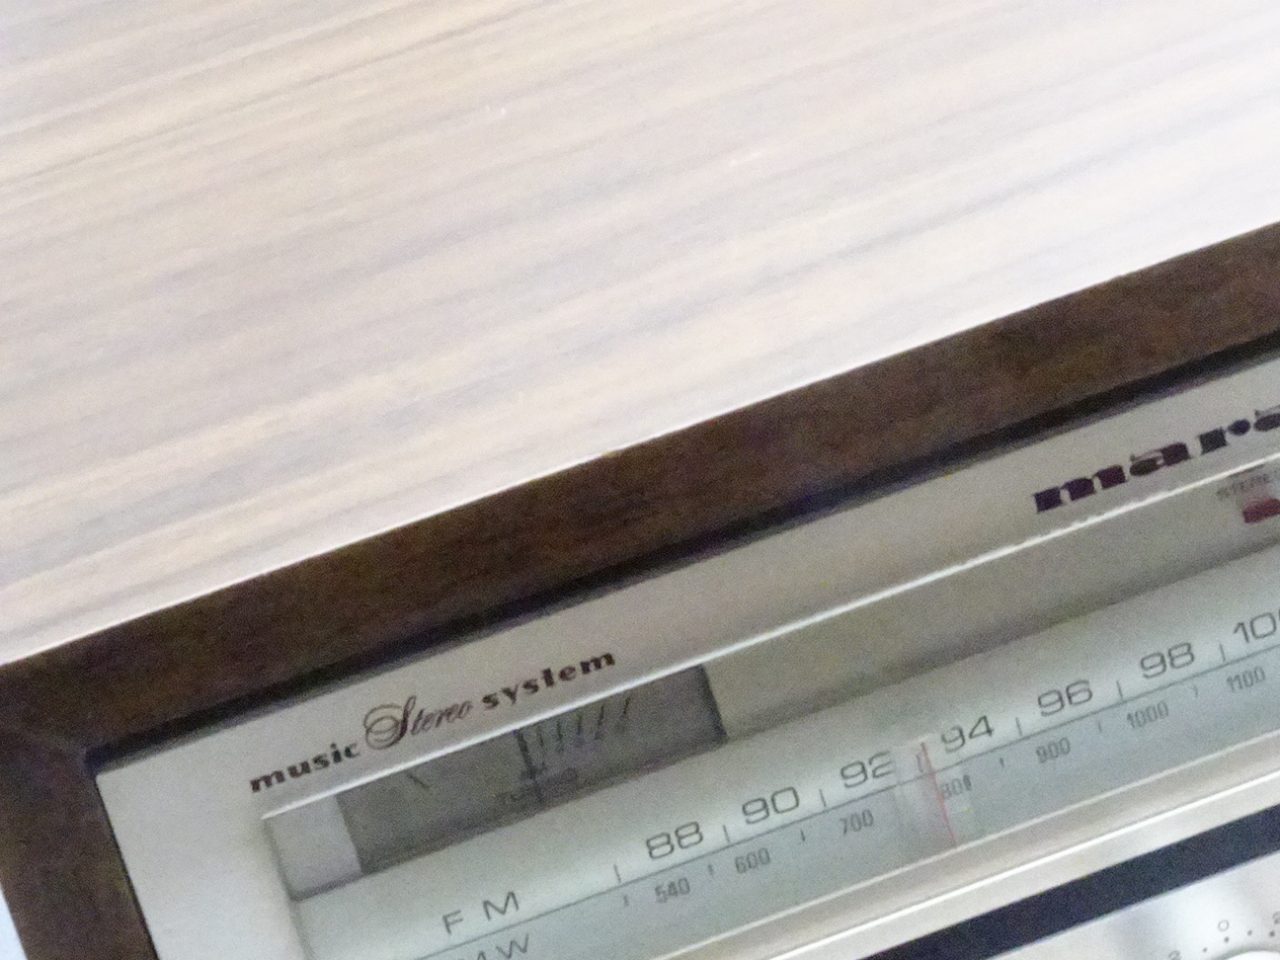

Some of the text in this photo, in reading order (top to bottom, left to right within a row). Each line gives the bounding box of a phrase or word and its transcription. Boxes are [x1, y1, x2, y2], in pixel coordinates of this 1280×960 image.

[250, 652, 616, 793] music Stereo system
[645, 821, 704, 860] 88
[741, 786, 801, 825] 90
[840, 750, 895, 789] 92
[940, 715, 994, 754] 94
[1037, 680, 1093, 717] 96
[1139, 642, 1195, 679] 98
[654, 877, 690, 903] 540
[734, 847, 771, 874] 600
[840, 809, 874, 835] 700
[1035, 737, 1070, 764] 900
[1126, 699, 1169, 734] 1000
[1226, 665, 1266, 692] 1100
